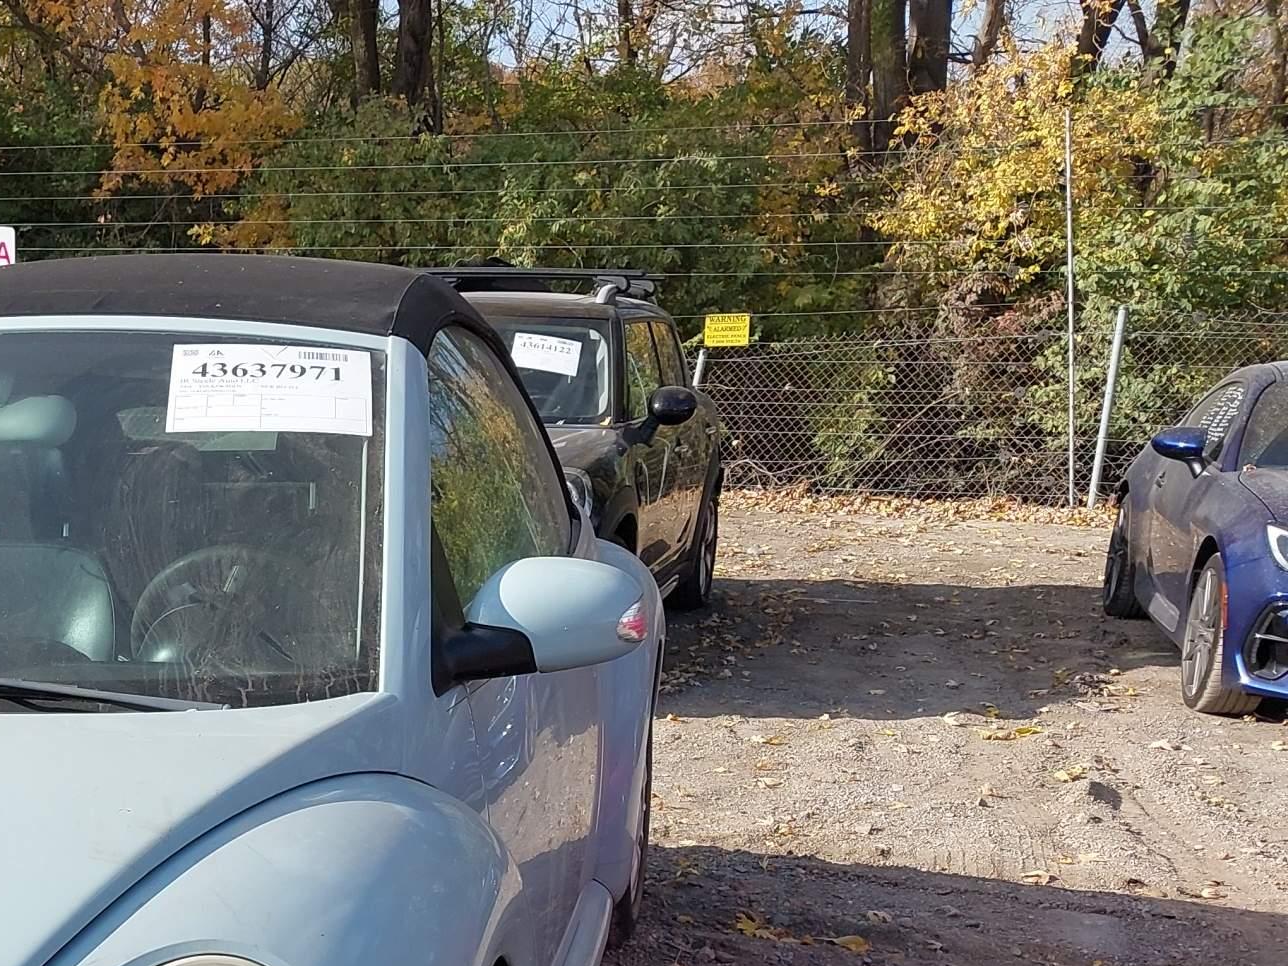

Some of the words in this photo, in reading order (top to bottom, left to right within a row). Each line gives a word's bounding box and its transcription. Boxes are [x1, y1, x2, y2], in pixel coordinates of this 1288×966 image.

[709, 315, 747, 323] WARNING
[520, 341, 572, 354] 43614122
[191, 362, 342, 382] 43637971
